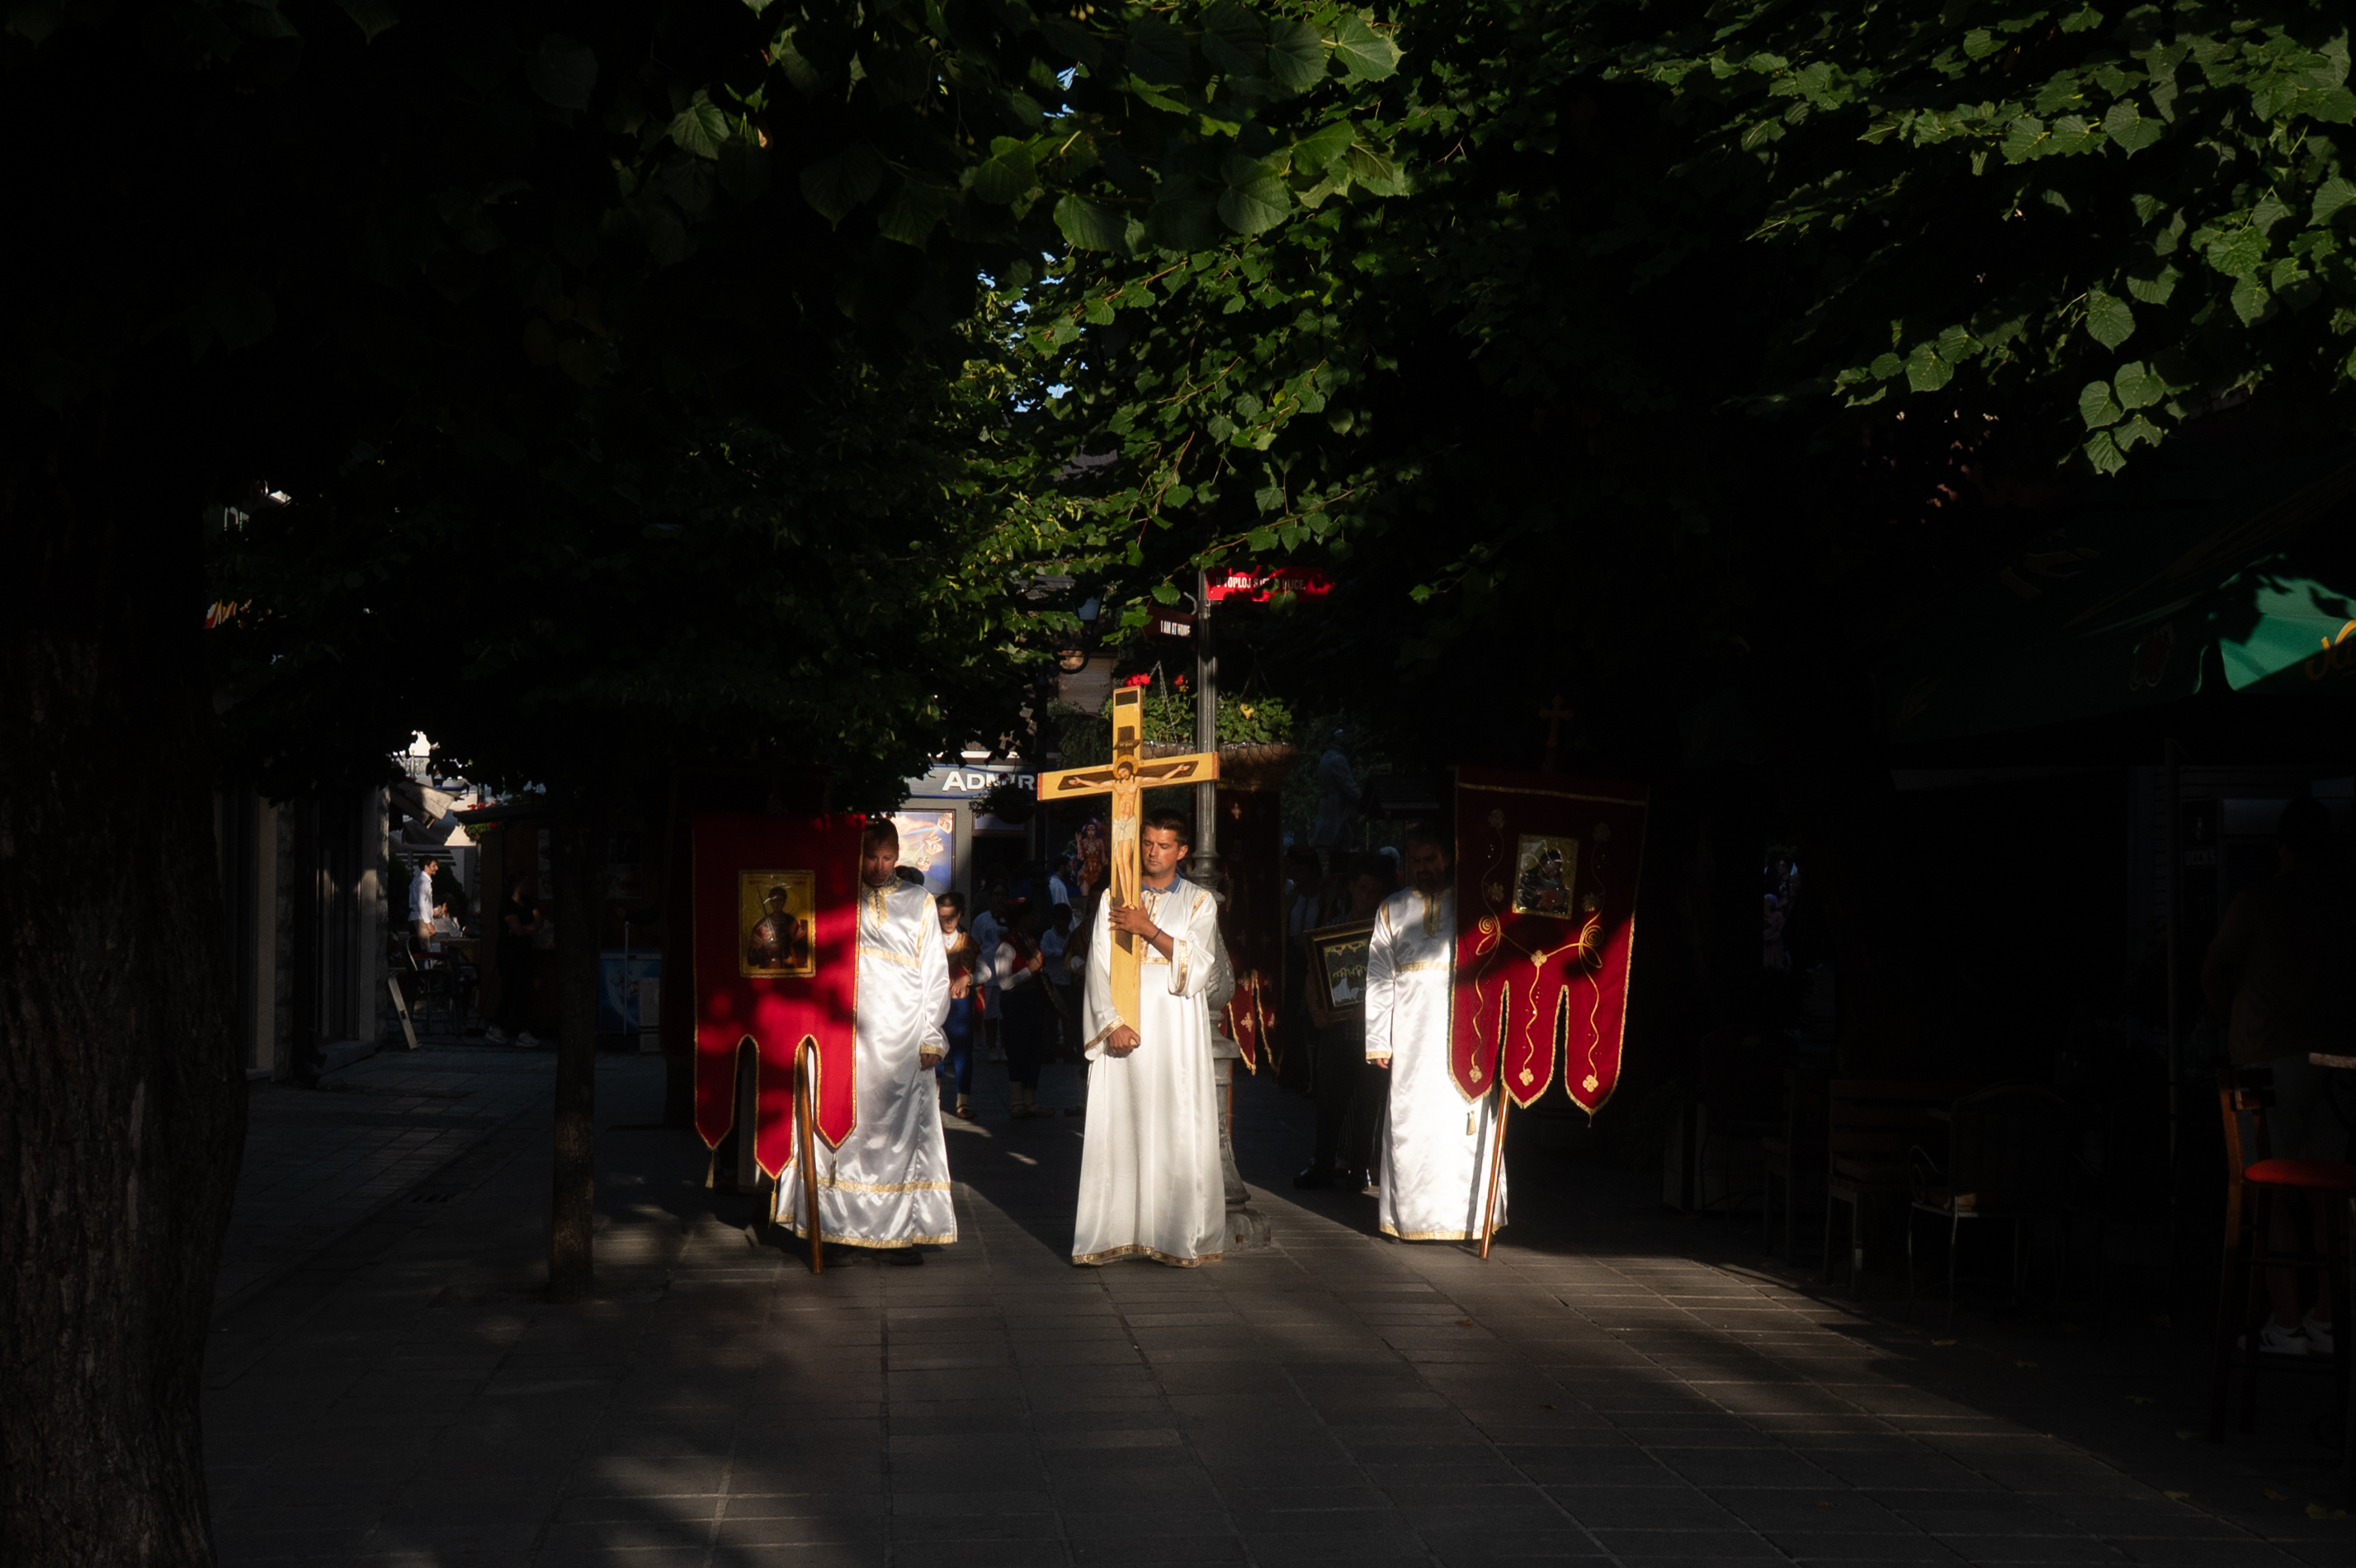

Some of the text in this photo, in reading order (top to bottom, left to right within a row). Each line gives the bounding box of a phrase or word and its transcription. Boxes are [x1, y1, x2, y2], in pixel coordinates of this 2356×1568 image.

[1216, 576, 1221, 588] U
[1224, 576, 1252, 588] TOPLOJ
[1164, 621, 1171, 634] AM
[1172, 622, 1178, 635] AT
